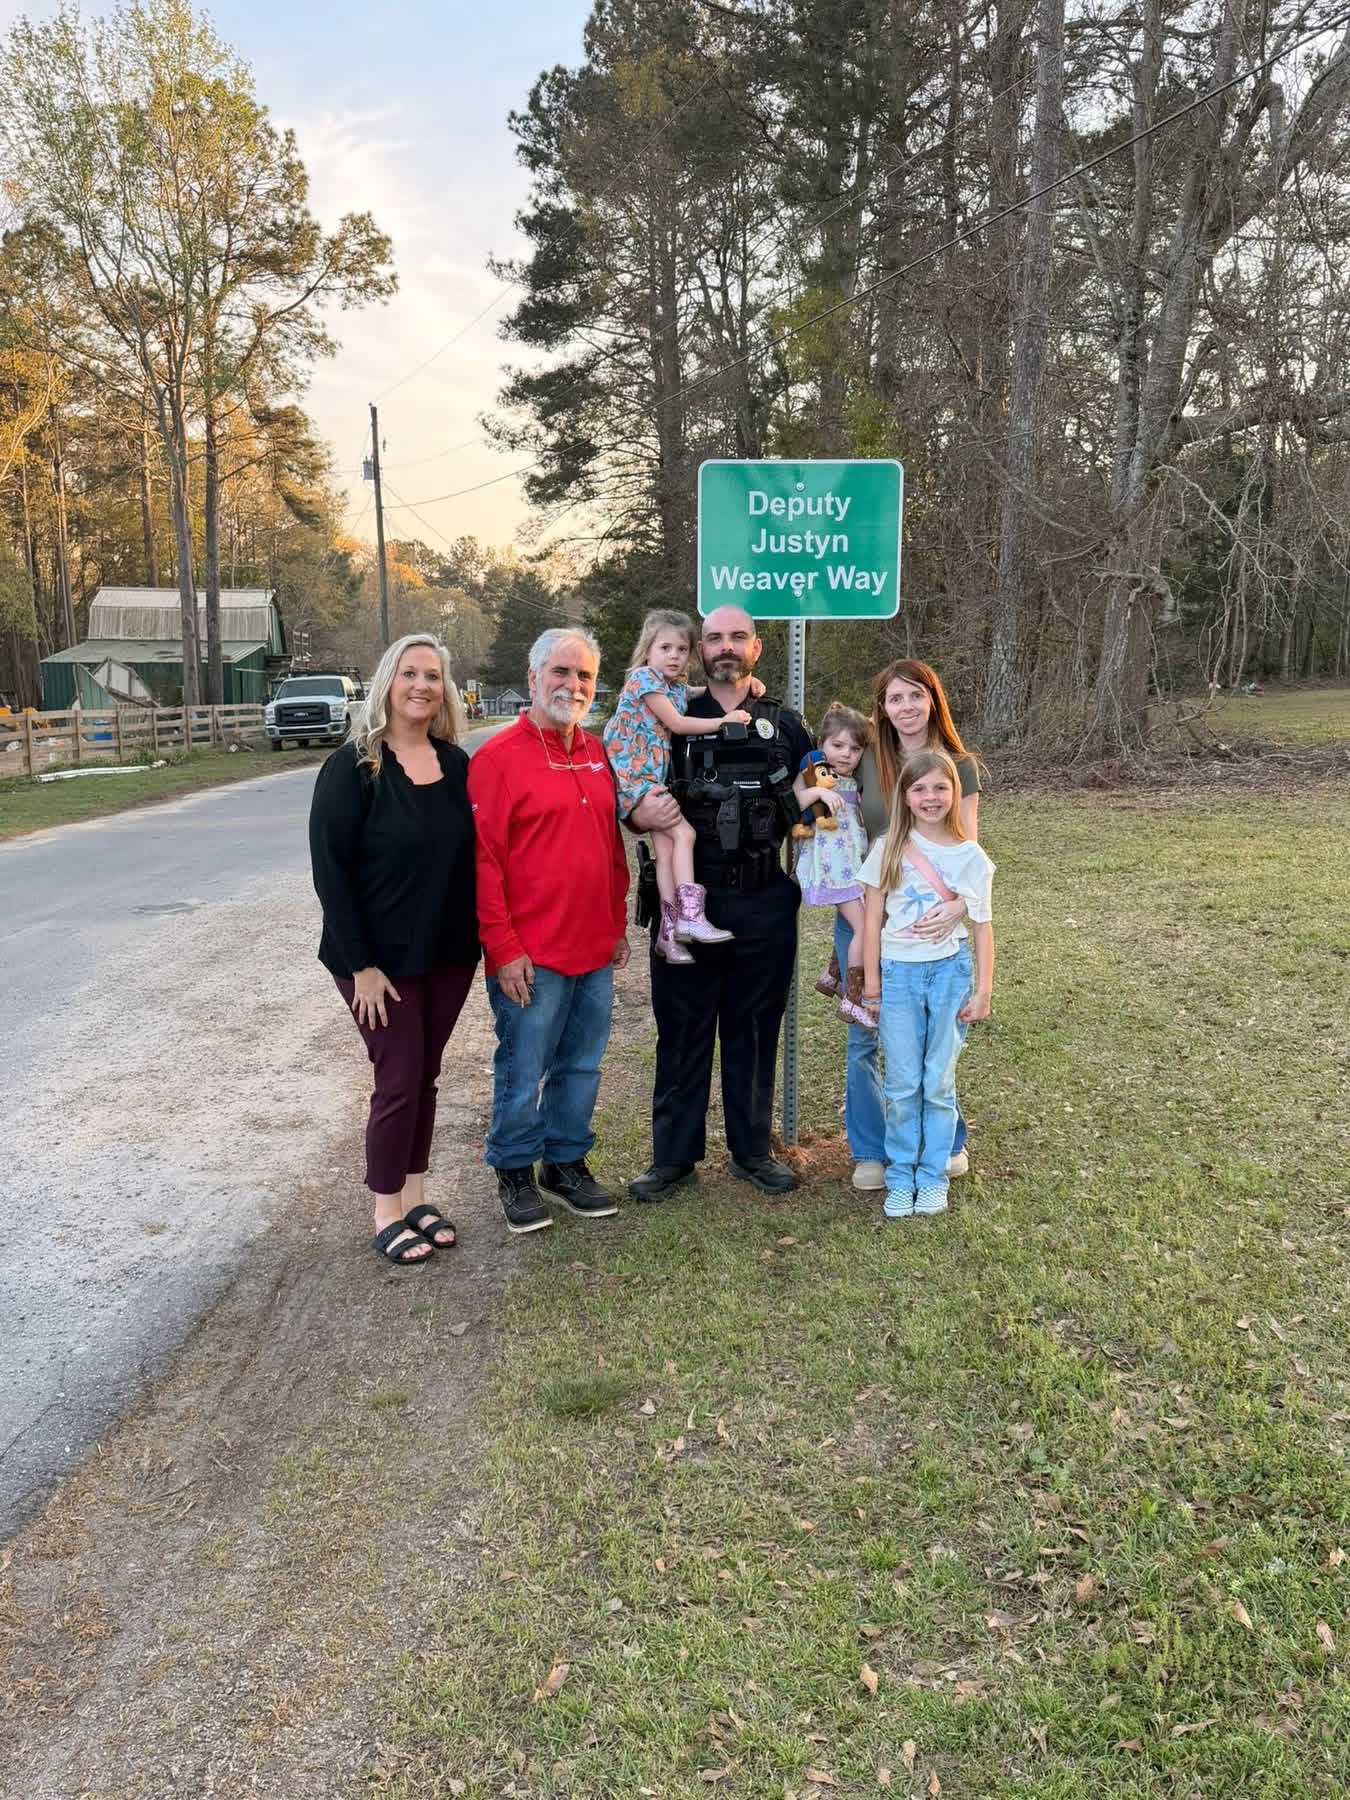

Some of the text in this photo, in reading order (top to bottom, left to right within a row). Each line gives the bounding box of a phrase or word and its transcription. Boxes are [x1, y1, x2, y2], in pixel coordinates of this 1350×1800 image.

[748, 491, 851, 521] Deputy
[751, 528, 849, 559] Justyn
[711, 566, 888, 596] Weaver Way
